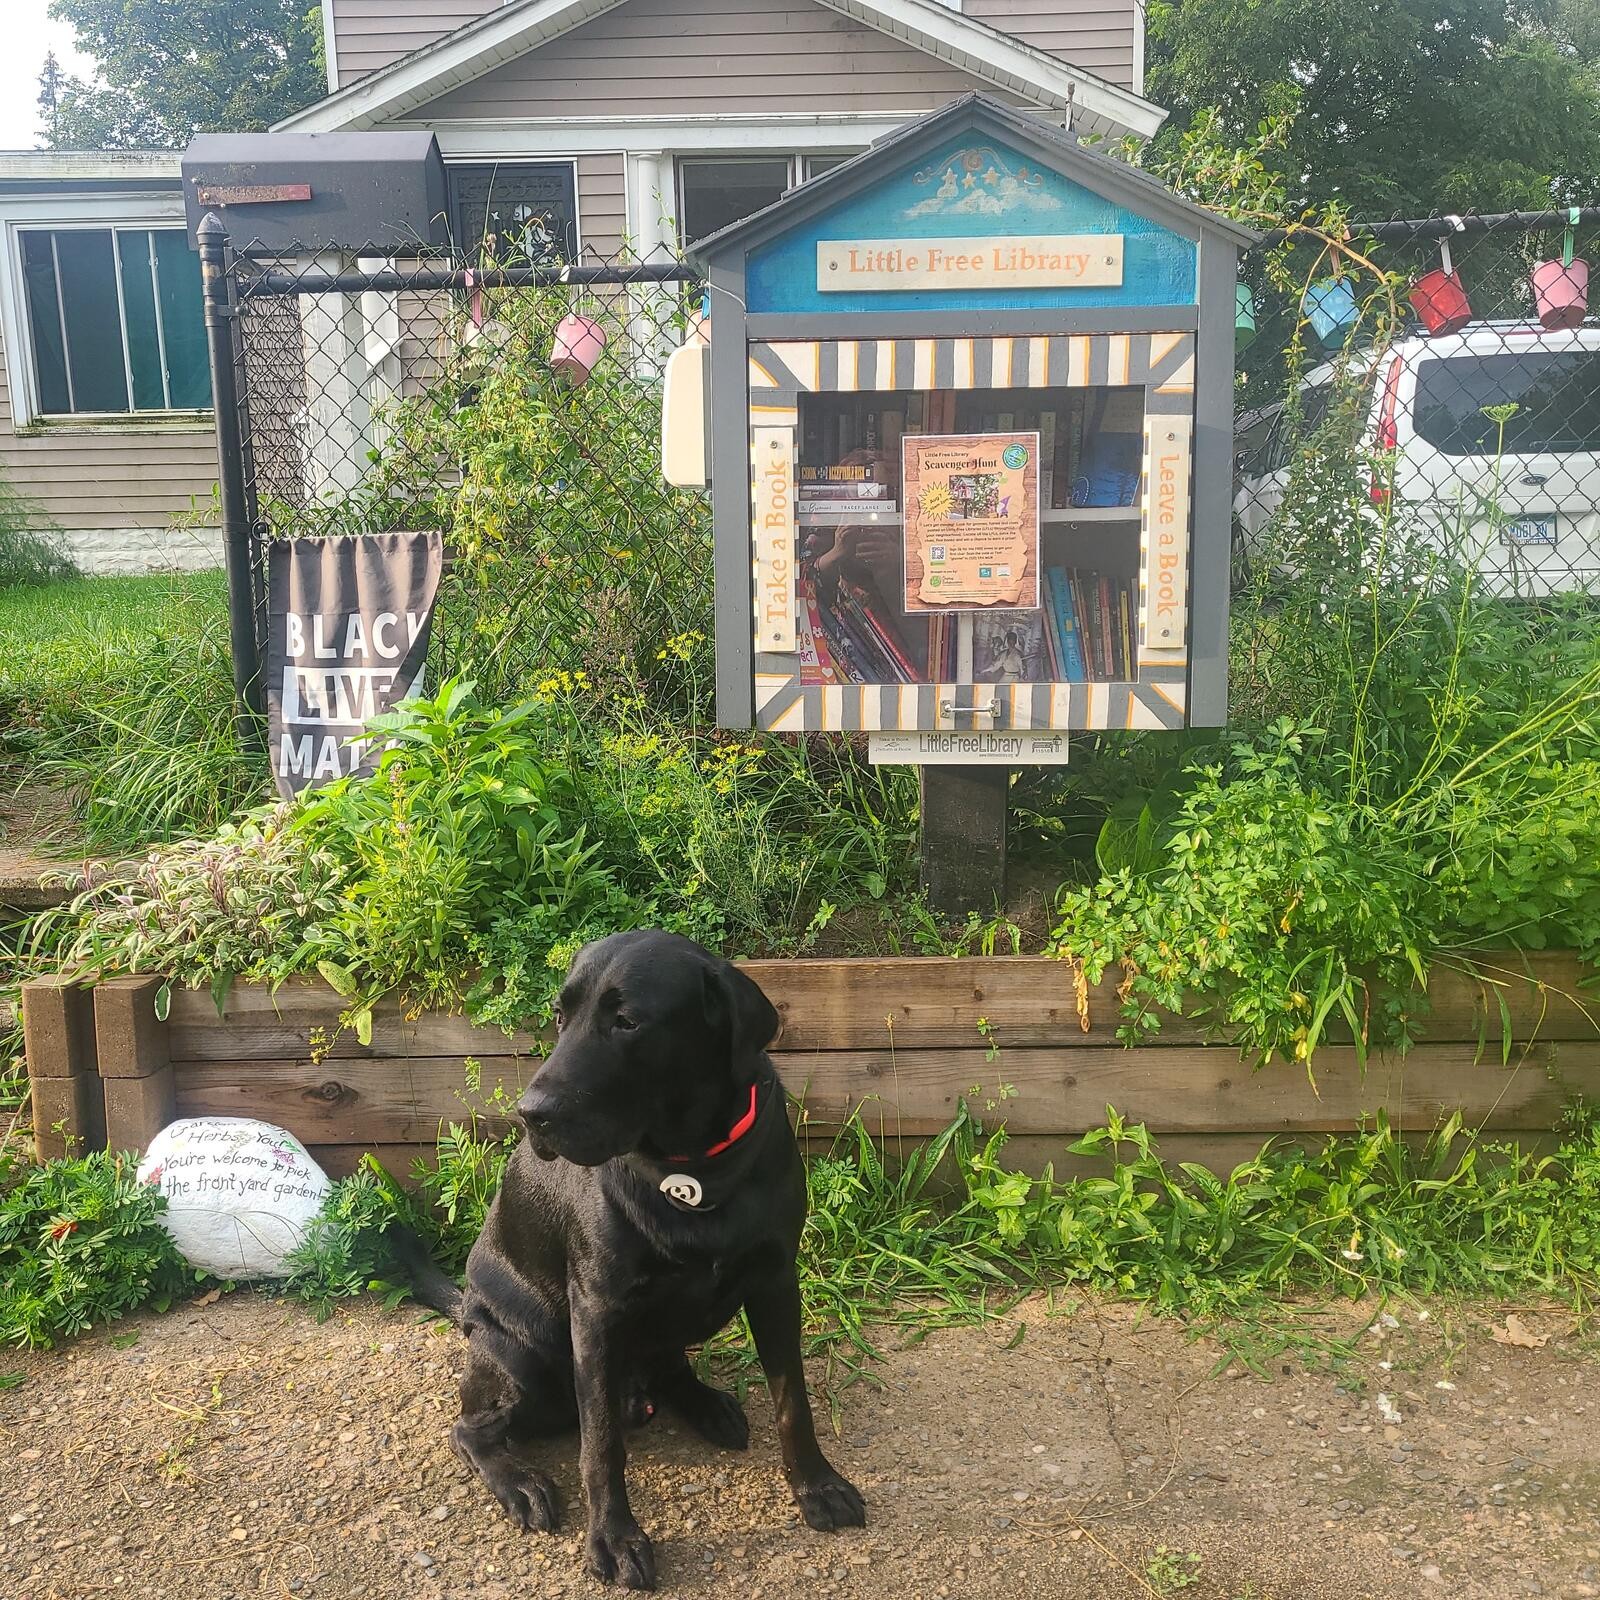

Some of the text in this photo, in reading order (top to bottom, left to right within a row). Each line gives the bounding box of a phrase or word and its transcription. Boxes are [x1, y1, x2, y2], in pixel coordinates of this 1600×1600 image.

[848, 247, 1091, 278] Little Free Library
[924, 457, 998, 471] Scavenger Hunt
[765, 457, 788, 624] Take a Book
[1157, 454, 1181, 618] Leave a Book
[212, 1150, 268, 1168] welcome
[271, 1158, 285, 1172] to
[283, 1164, 312, 1181] pick
[166, 1172, 323, 1203] the front yard garden!
